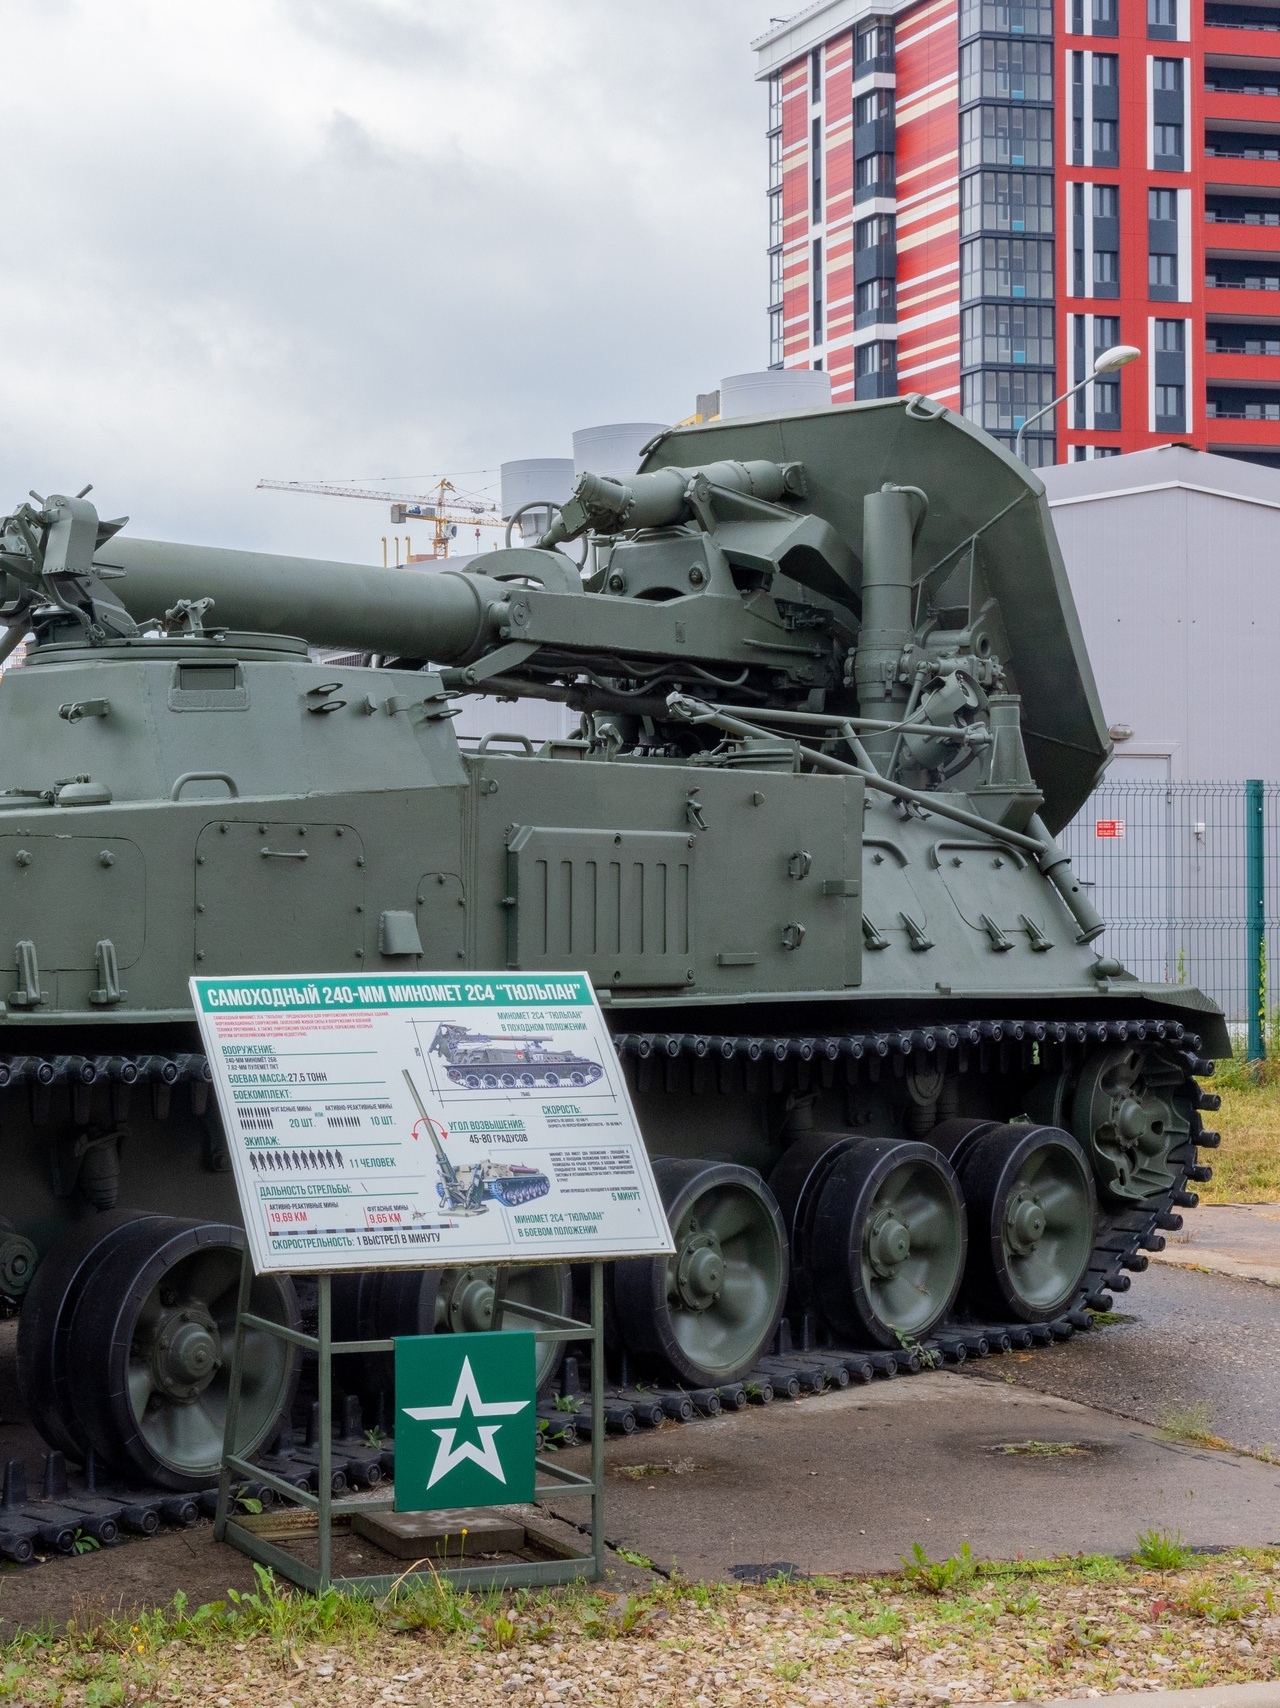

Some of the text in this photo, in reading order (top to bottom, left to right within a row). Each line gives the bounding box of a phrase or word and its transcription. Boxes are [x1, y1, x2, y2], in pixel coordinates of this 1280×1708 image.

[207, 983, 580, 1007] САМОХОДНЫЙ 240-ММ МИНОМЕТ 2С4 “ТЮЛЬПАН”
[497, 1012, 530, 1020] МИНОМЕТ
[500, 1024, 506, 1032] В
[506, 1023, 544, 1032] ПОХОДНОМ
[222, 1045, 276, 1054] ВООРУЖЕНИЕ:
[228, 1074, 258, 1084] БОЕВАЯ
[306, 1072, 328, 1082] ТОНН
[232, 1090, 292, 1100] БОЕКОМПЛЕКТ:
[542, 1104, 581, 1114] СКОРОСТЬ:
[289, 1118, 316, 1128] 20 ШТ.
[370, 1116, 396, 1126] 10 ШТ.
[448, 1118, 526, 1130] УГОЛ ВОЗВЫШЕНИЯ:
[244, 1136, 281, 1147] ЭКИПАЖ:
[469, 1133, 528, 1144] 45-80 ГРАДУСОВ
[350, 1157, 396, 1168] 11 ЧЕЛОВЕК
[259, 1184, 352, 1198] ДАЛЬНОСТЬ СТРЕЛЬБЫ:
[611, 1191, 641, 1201] 5 МИНУТ
[294, 1212, 308, 1221] КМ
[388, 1213, 402, 1223] КМ
[514, 1213, 548, 1224] МИНОМЕТ
[550, 1213, 564, 1223] 2С4
[518, 1225, 598, 1237] В БОЕВОМ ПОЛОЖЕНИИ
[272, 1237, 355, 1250] СКОРОСТРЕЛЬНОСТЬ:
[363, 1235, 400, 1246] ВЫСТРЕЛ
[401, 1234, 407, 1244] В
[408, 1233, 441, 1244] МИНУТУ
